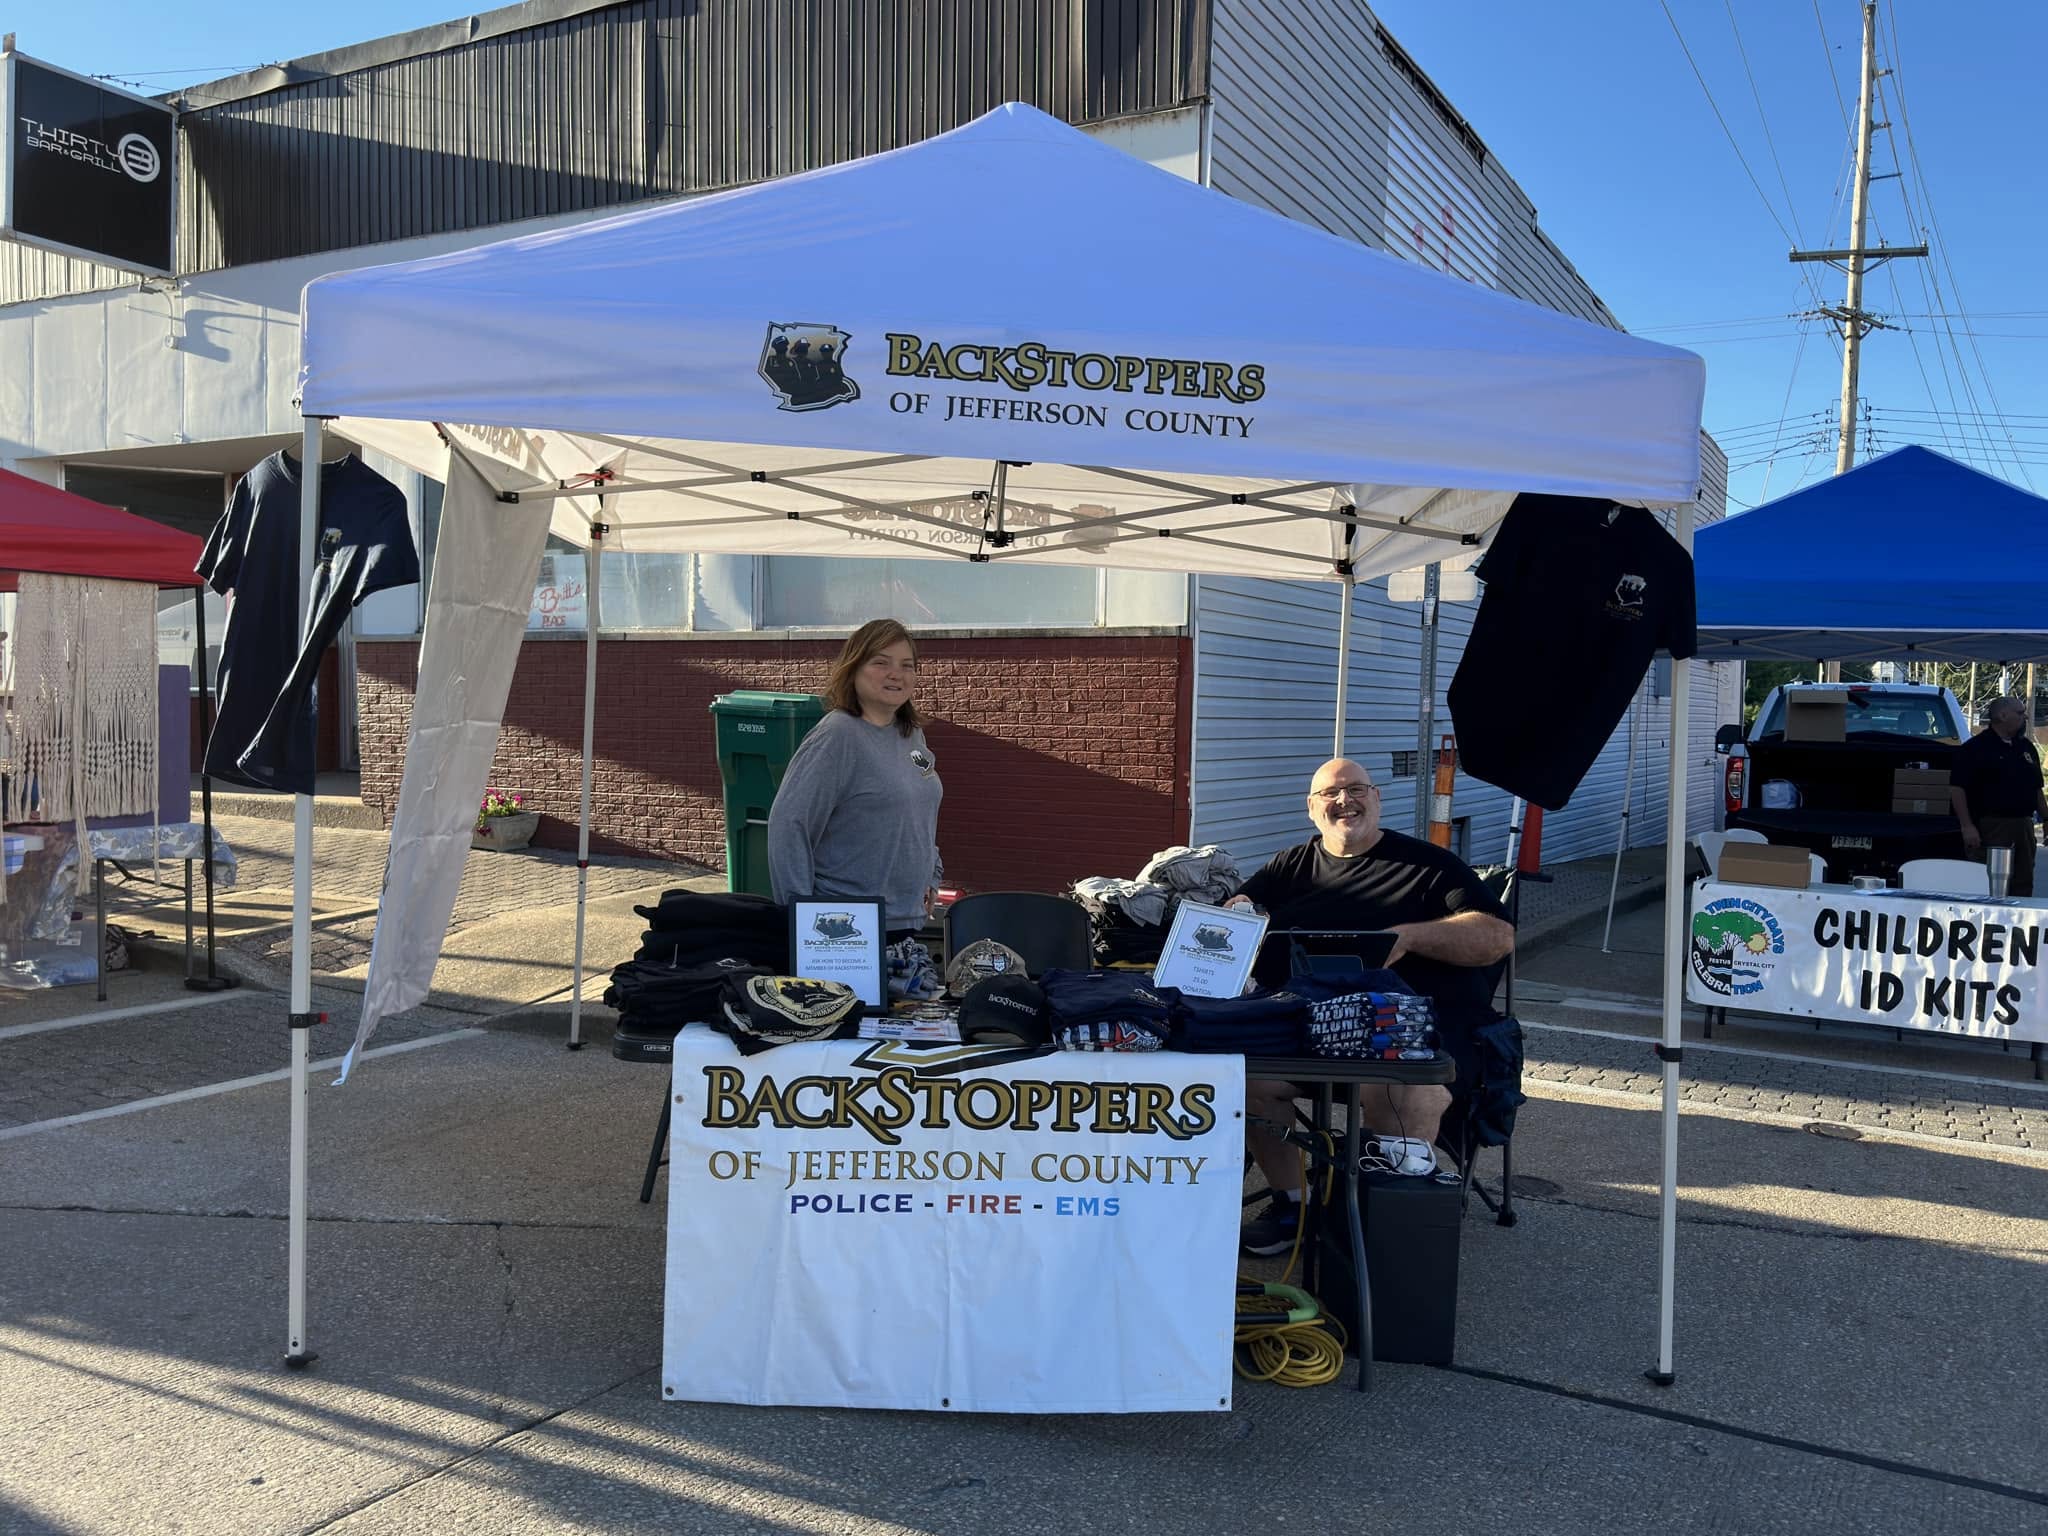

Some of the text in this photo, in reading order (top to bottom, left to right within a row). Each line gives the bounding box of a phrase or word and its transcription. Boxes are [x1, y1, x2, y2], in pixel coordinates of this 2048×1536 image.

[20, 116, 121, 160] THIRTY
[886, 333, 1266, 404] BACKSTOPPERS
[890, 392, 1255, 438] OF JEFFERSON COUNTY
[1704, 897, 1785, 954] TWIN CITY DAYS
[1709, 957, 1732, 965] FESTUS
[1733, 960, 1760, 968] CRYSTAL
[1860, 969, 2021, 1026] ID KITS
[702, 1066, 1216, 1145] BACKSTOPPERS
[709, 1150, 1208, 1190] OF JEFFERSON COUNTY
[791, 1193, 913, 1214] POLICE
[947, 1194, 1022, 1214] FIRE
[1056, 1196, 1121, 1216] EMS
